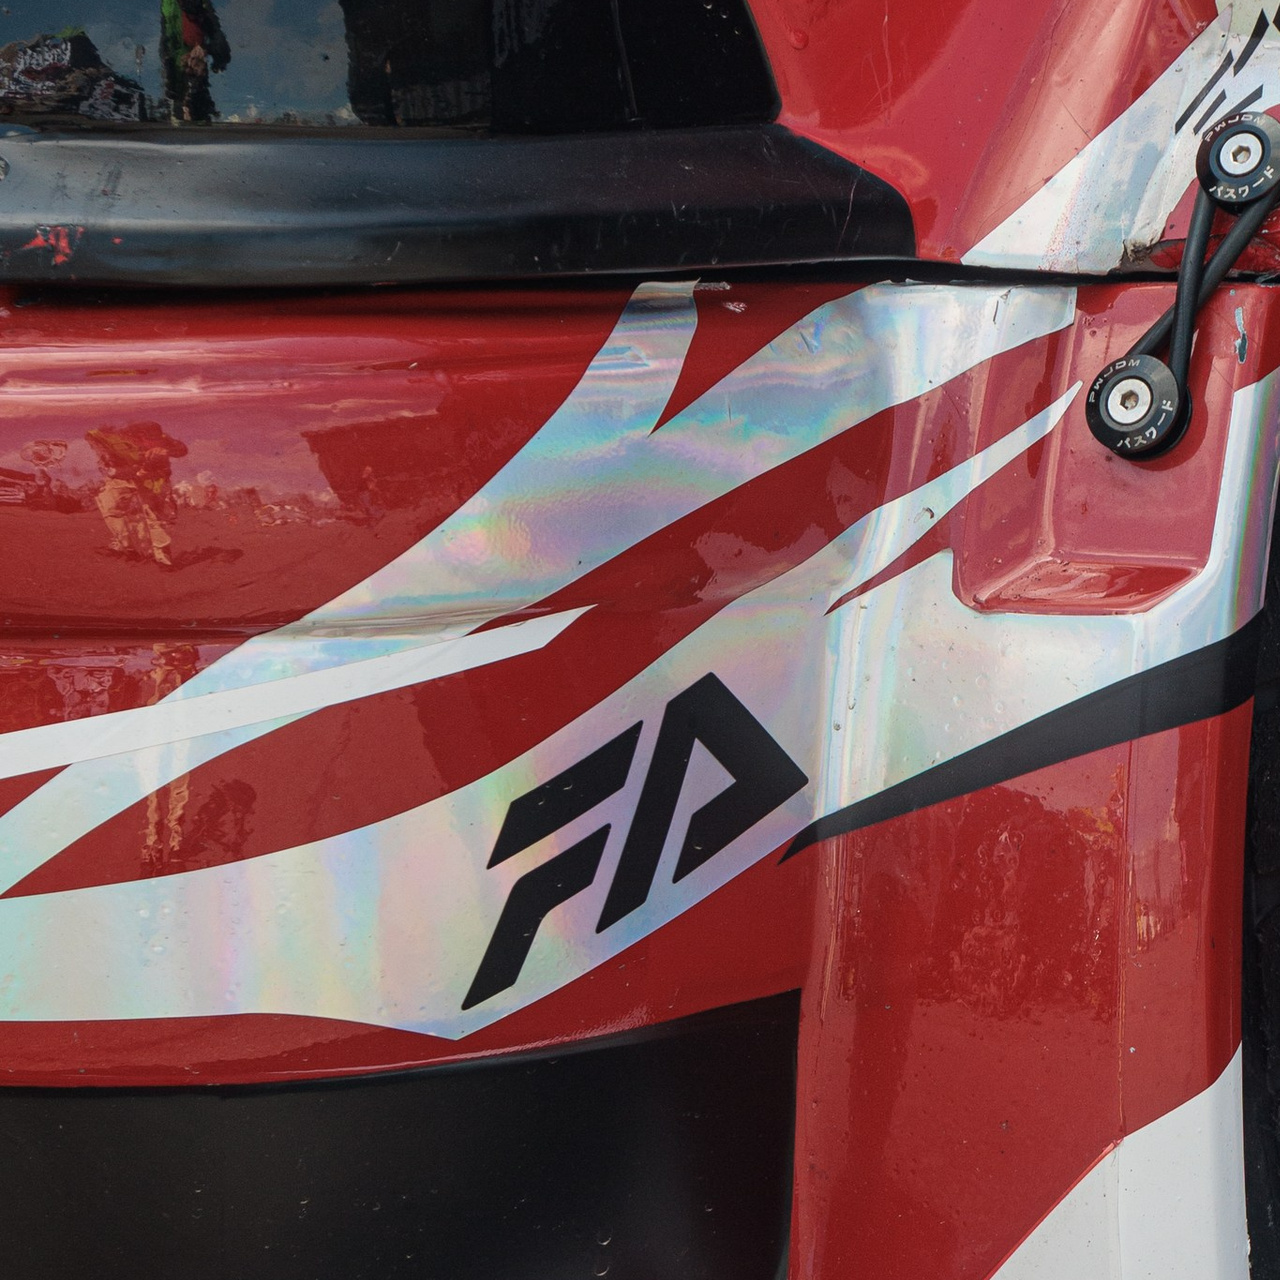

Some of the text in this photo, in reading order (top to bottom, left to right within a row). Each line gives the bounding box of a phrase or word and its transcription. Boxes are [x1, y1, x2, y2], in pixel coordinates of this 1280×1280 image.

[1204, 113, 1266, 142] PWJDM
[1208, 164, 1275, 200] パスワード
[1088, 358, 1141, 403] PWJDM
[1116, 399, 1174, 449] パスワード
